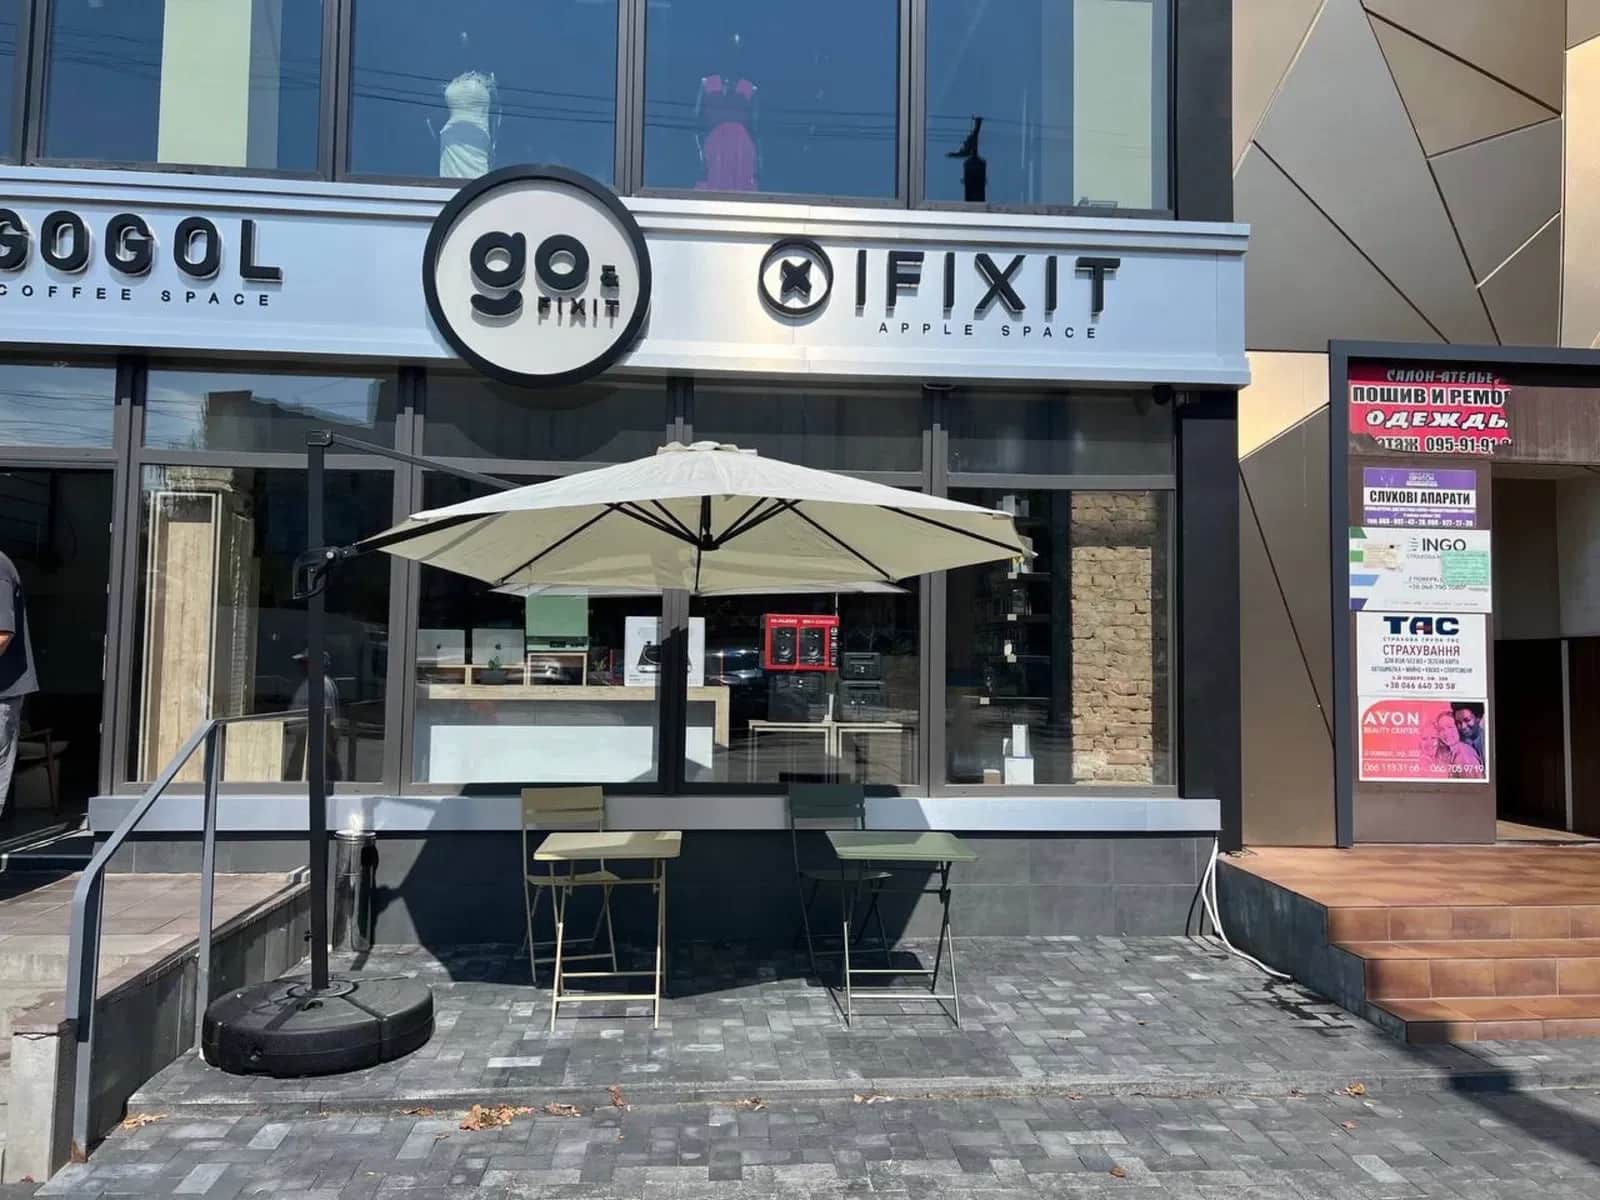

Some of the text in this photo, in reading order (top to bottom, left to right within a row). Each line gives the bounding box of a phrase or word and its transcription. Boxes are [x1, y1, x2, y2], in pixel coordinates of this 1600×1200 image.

[470, 231, 589, 316] go
[855, 249, 1121, 314] IFIXIT
[161, 290, 269, 306] SPACE
[538, 296, 620, 320] FIXIT
[879, 323, 1096, 339] APPLE SPACE
[1353, 386, 1426, 403] ПОШИВ
[1432, 388, 1444, 404] И
[1370, 490, 1470, 505] СЛУХОВІ АПАРАТИ
[1422, 537, 1467, 551] INGO
[1383, 616, 1459, 635] ТАС
[1383, 644, 1460, 656] СТРАХУВАННЯ
[1364, 711, 1419, 726] AVON
